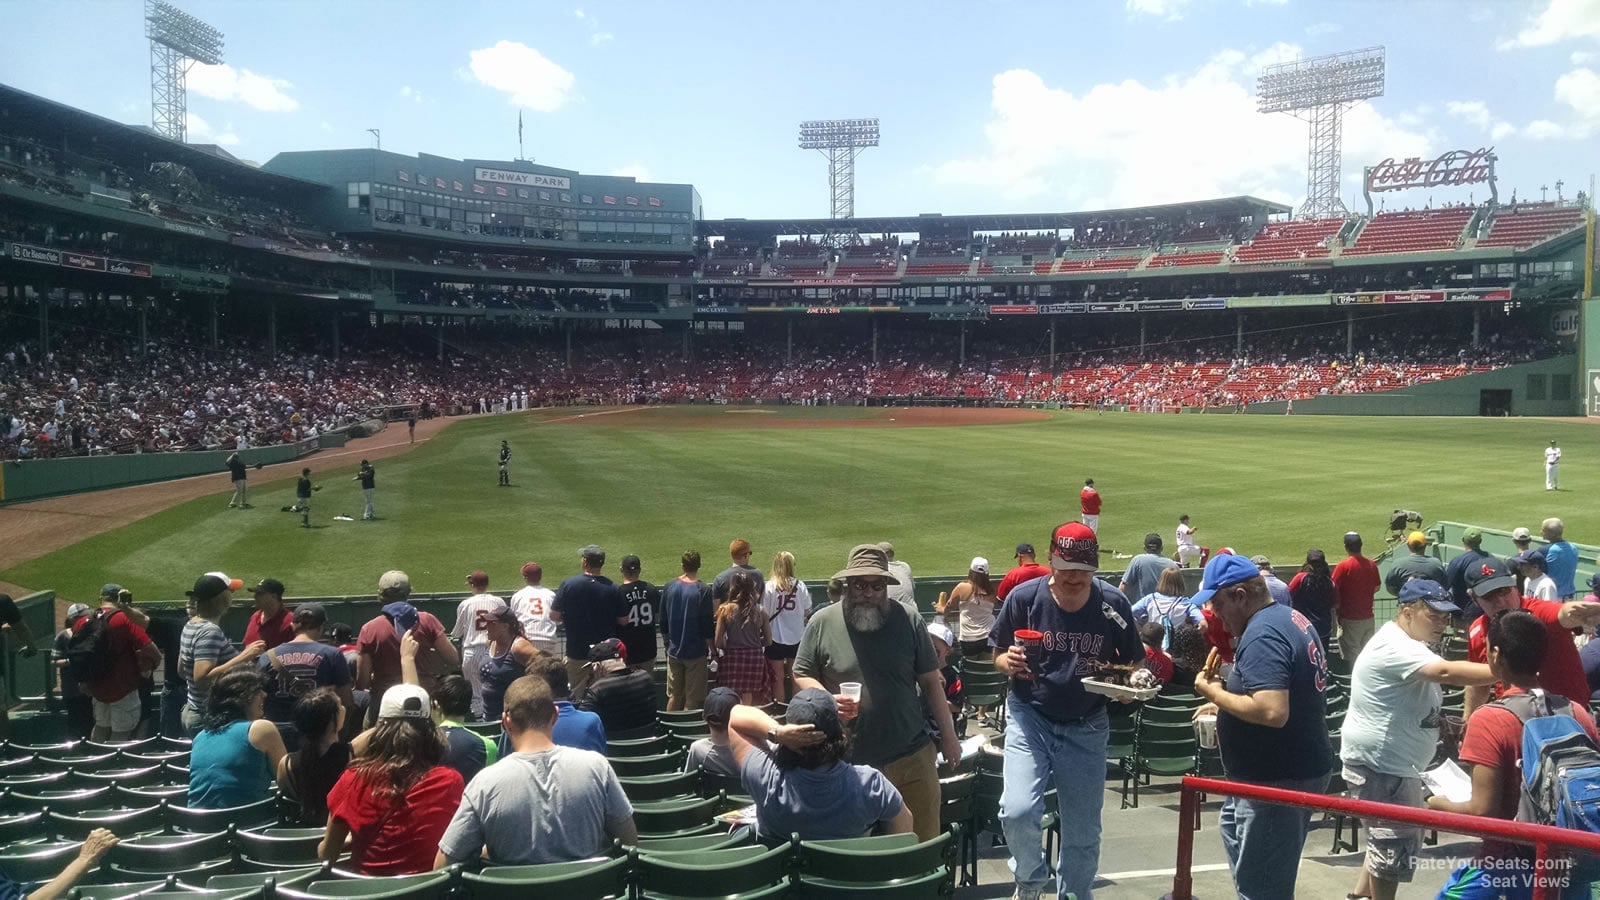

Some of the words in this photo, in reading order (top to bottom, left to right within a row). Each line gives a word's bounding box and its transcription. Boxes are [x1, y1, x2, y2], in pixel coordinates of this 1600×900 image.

[481, 171, 528, 183] FENWAY
[535, 176, 564, 187] PARK
[1552, 314, 1578, 332] Gulf
[625, 590, 648, 603] SALE
[529, 598, 543, 615] 3
[628, 602, 653, 627] 49
[1043, 630, 1104, 656] OSTON
